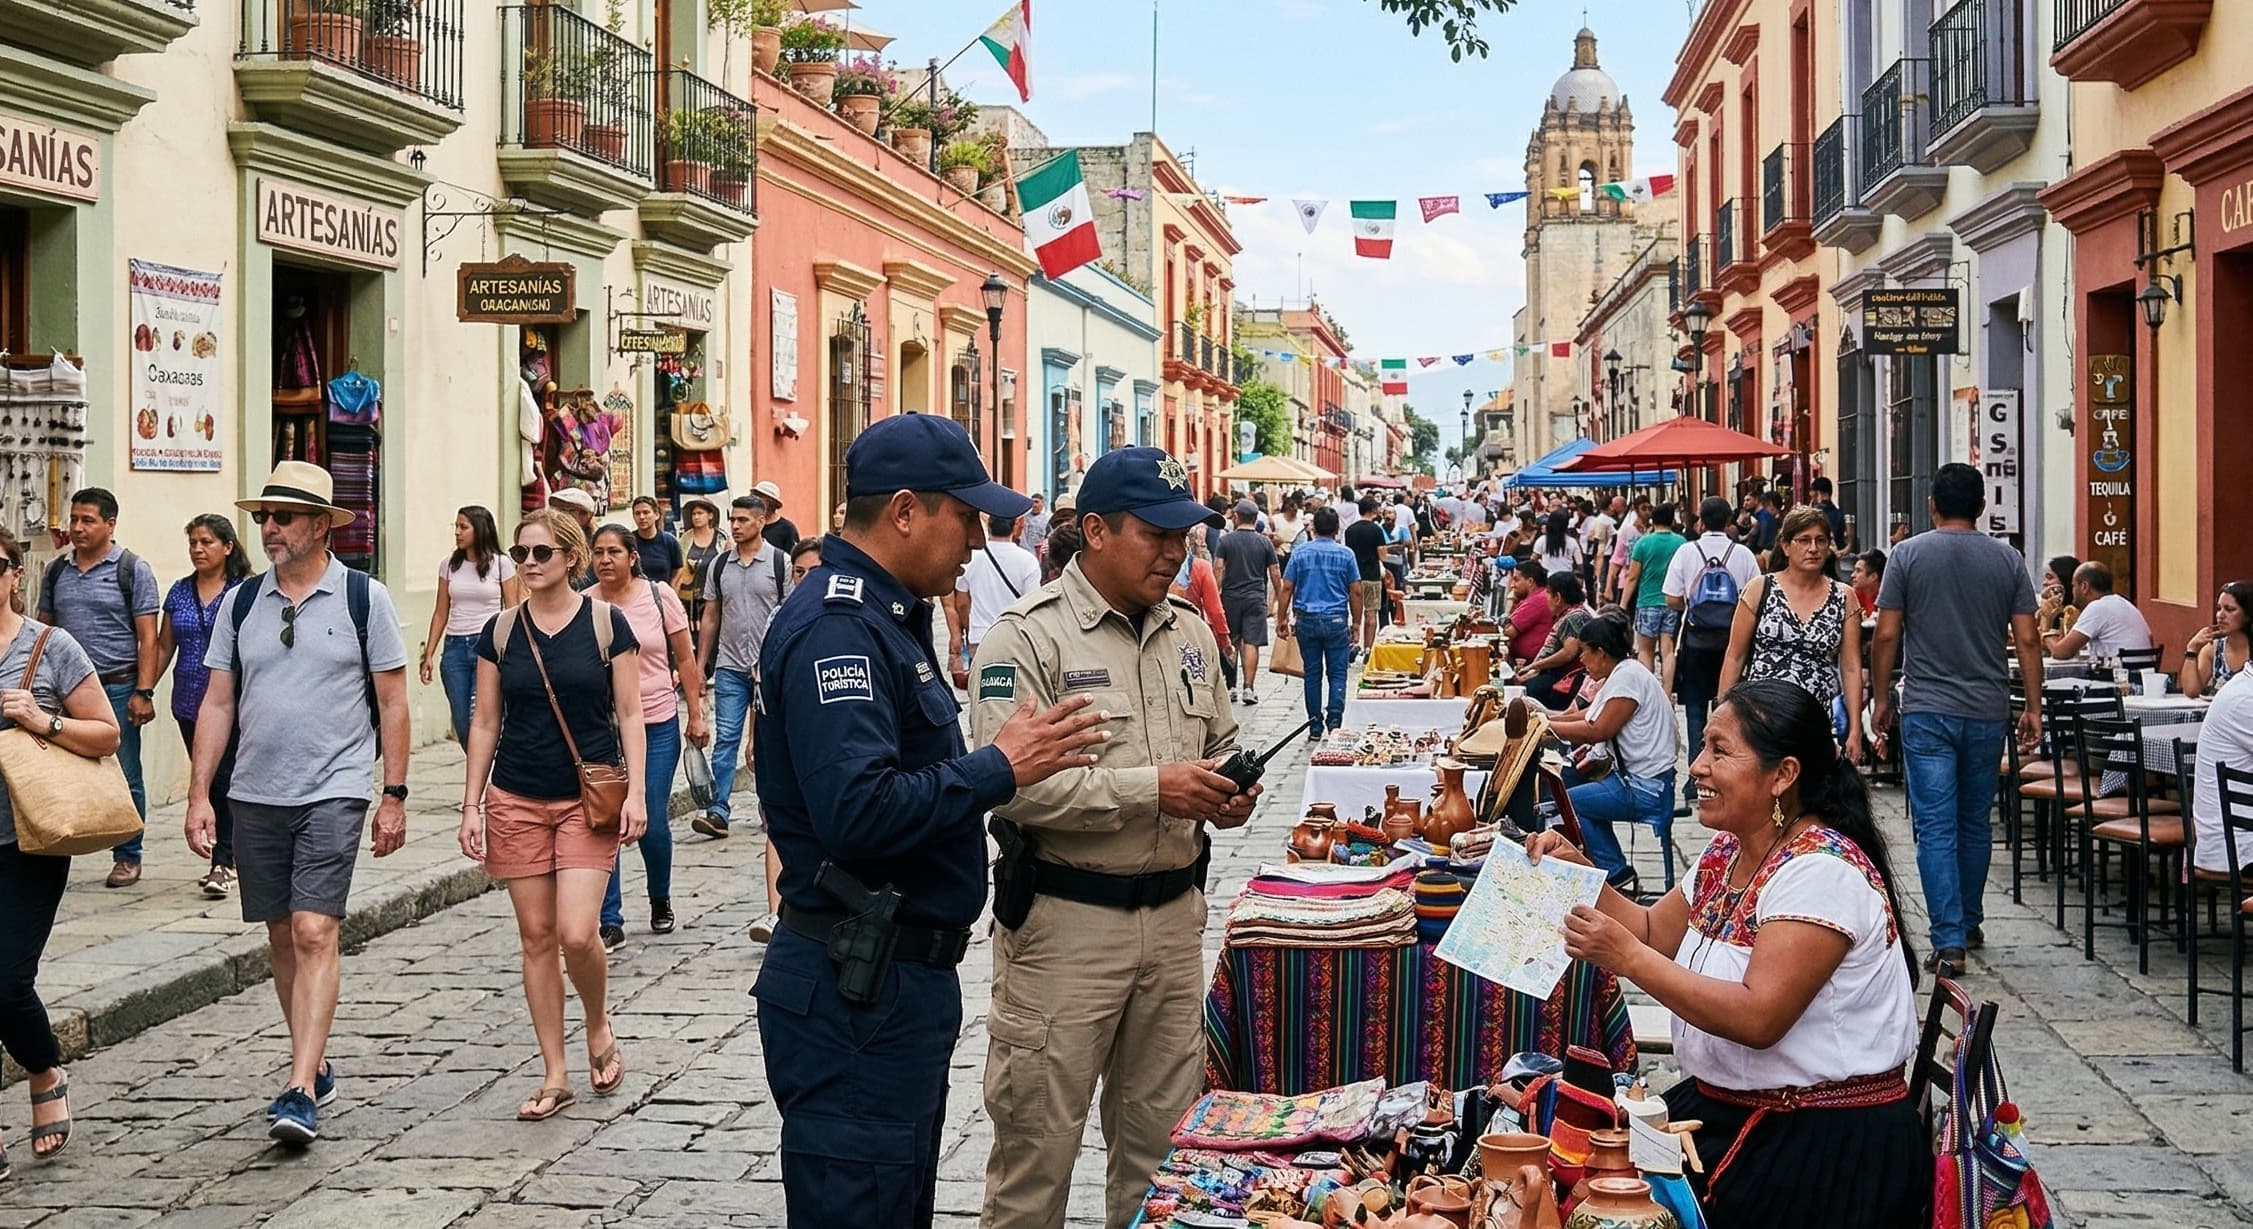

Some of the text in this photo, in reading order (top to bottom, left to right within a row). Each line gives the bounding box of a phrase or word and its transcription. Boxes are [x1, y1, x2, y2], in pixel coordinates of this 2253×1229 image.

[264, 189, 398, 258] ARTESANÍAS
[469, 274, 563, 295] ARTESANÍAS
[2089, 481, 2131, 498] TEQUILA
[2094, 527, 2127, 546] CAFÉ
[821, 663, 866, 681] POLICÍA
[821, 677, 869, 693] TURÍSTICA
